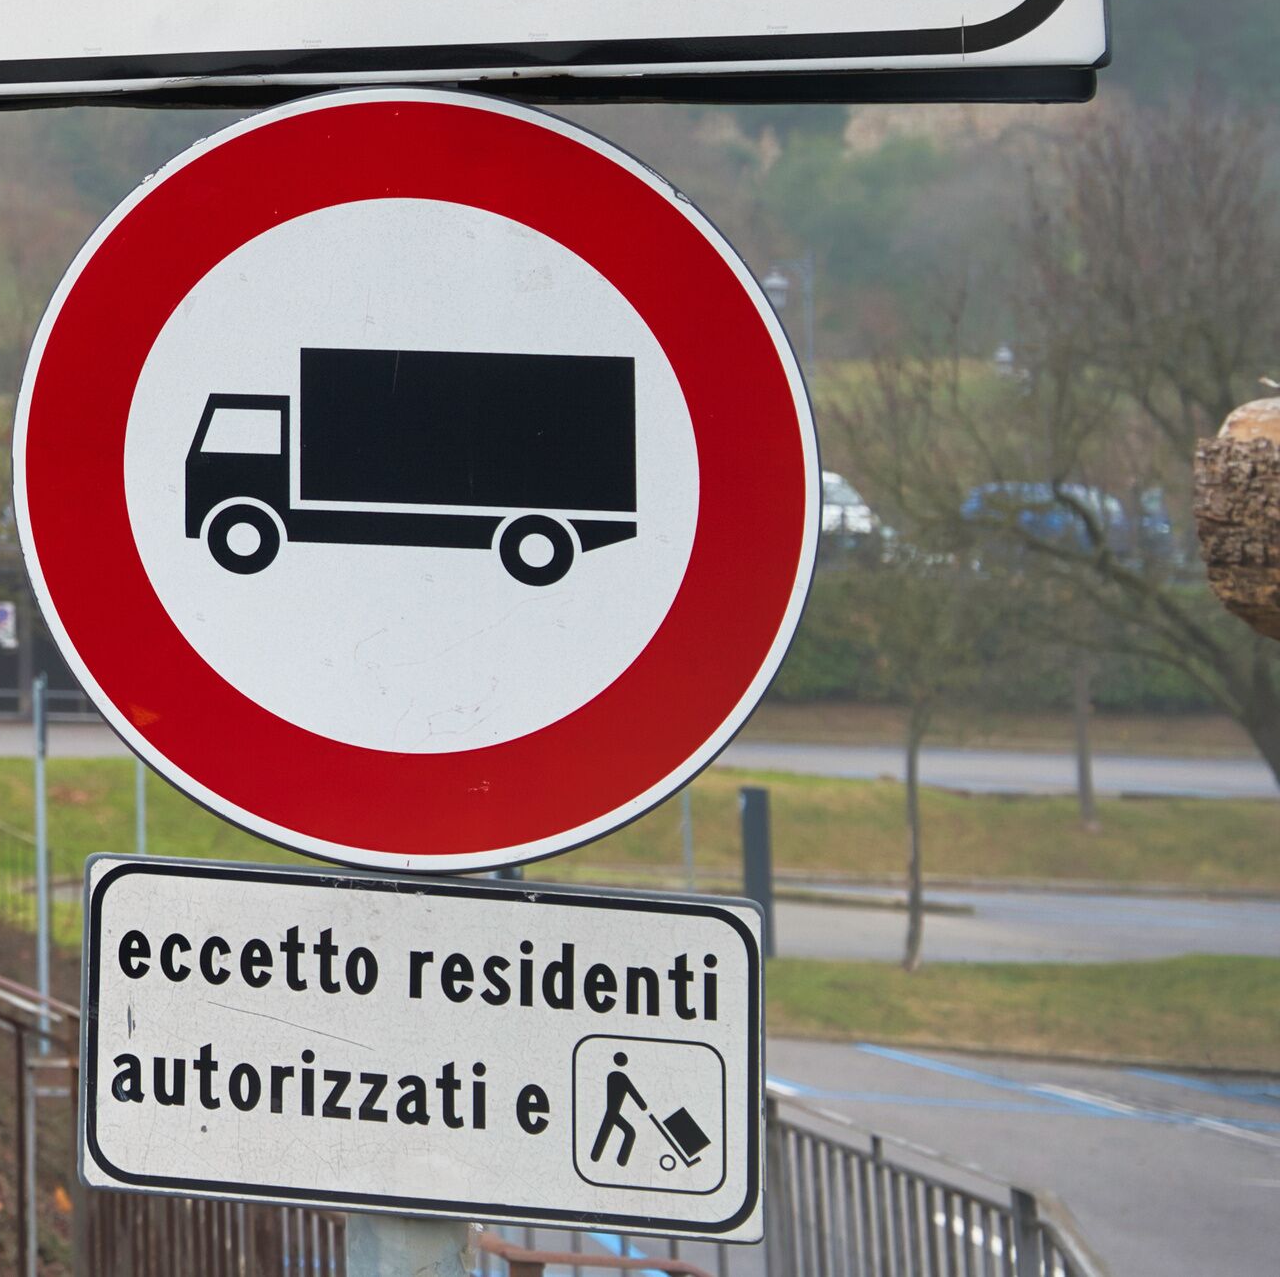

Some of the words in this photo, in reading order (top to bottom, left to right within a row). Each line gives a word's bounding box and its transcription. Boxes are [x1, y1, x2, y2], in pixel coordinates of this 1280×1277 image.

[119, 926, 379, 996] eccetto
[409, 939, 718, 1021] residenti
[111, 1043, 487, 1130] autorizzati
[517, 1083, 550, 1135] e
